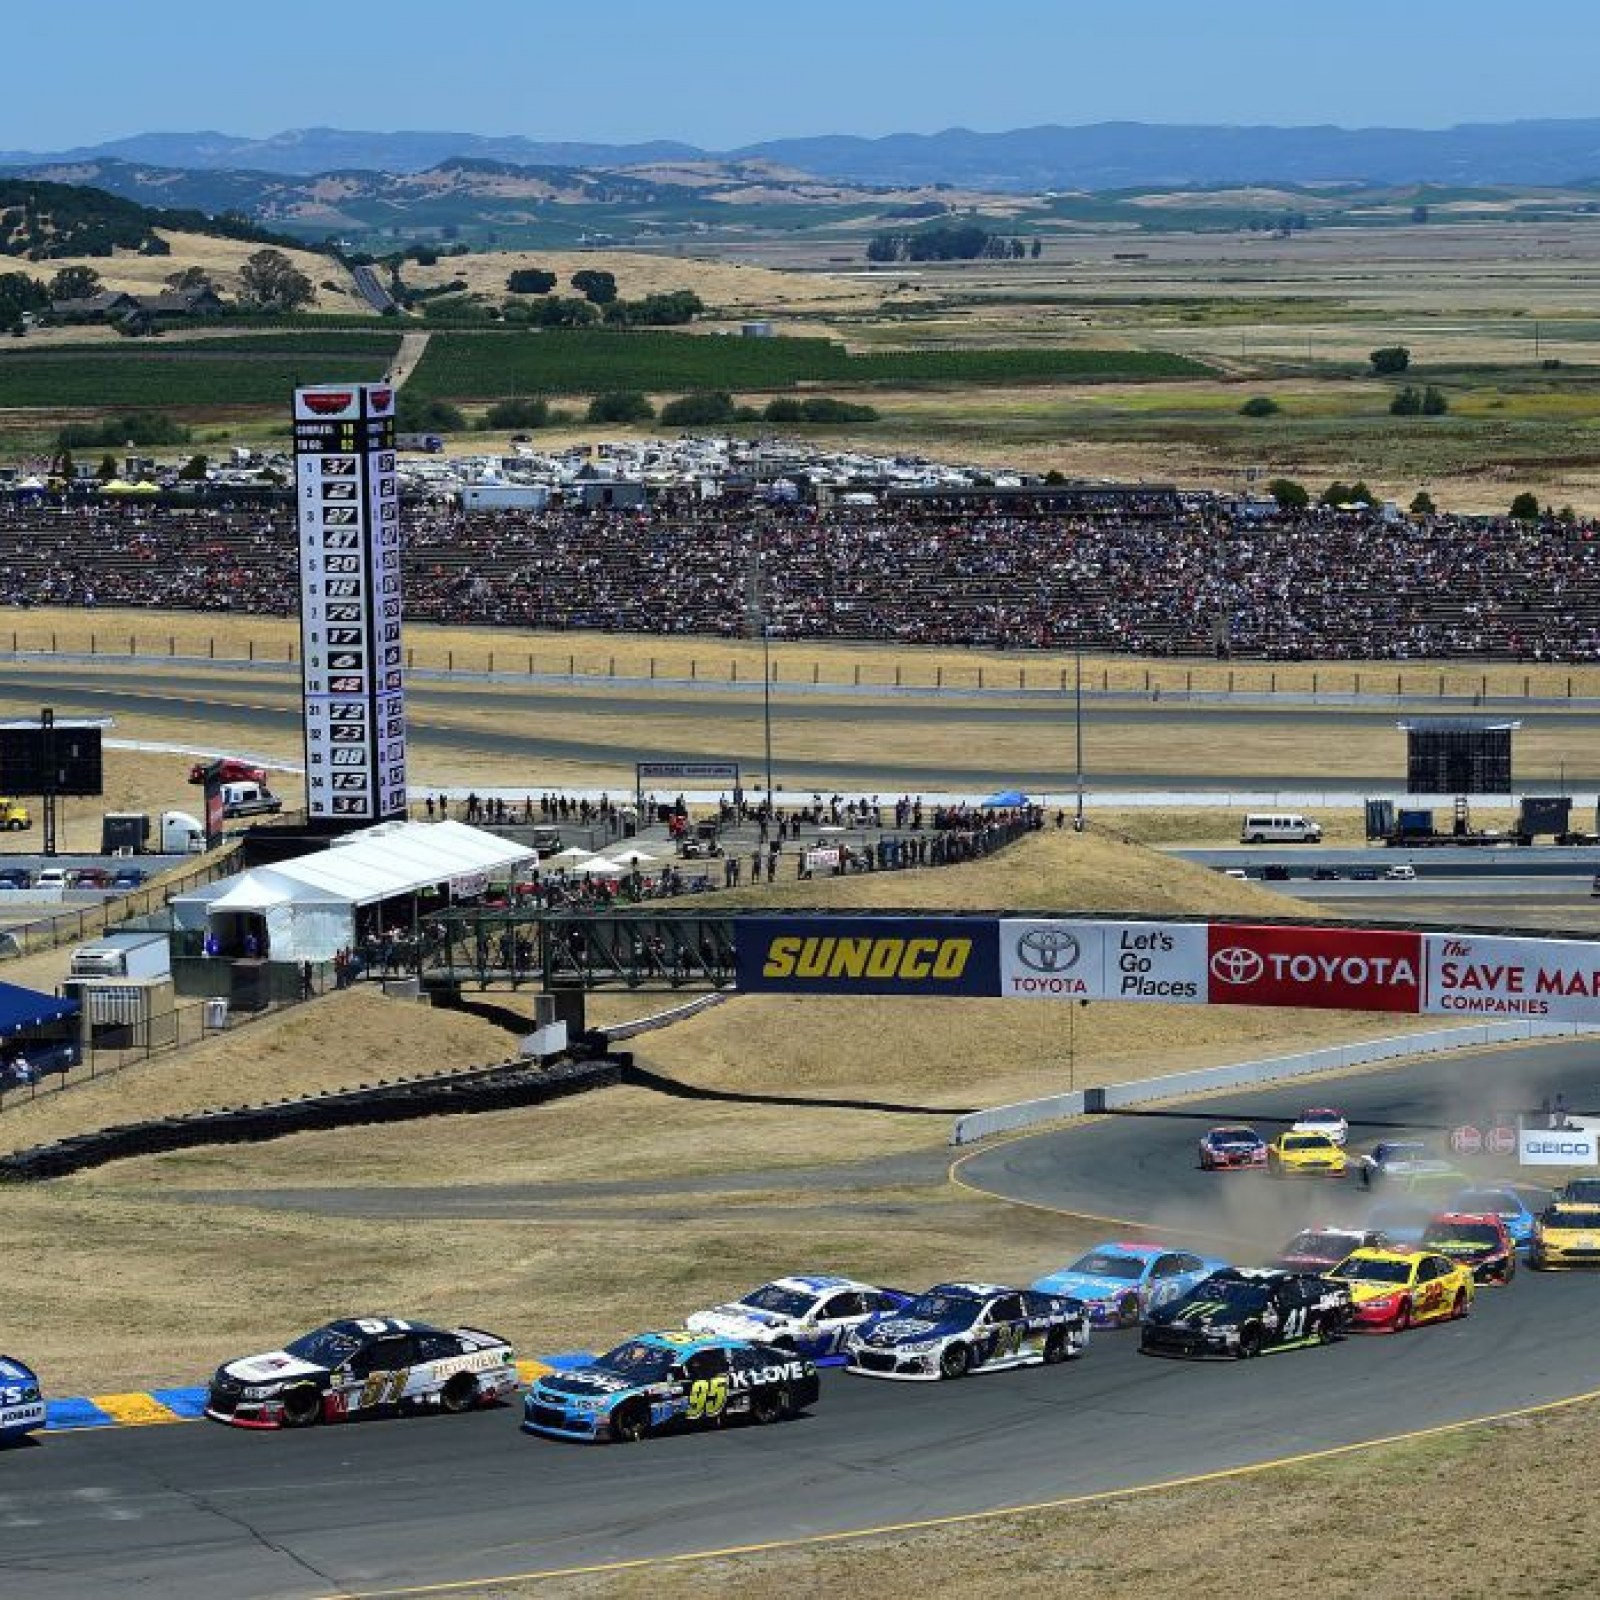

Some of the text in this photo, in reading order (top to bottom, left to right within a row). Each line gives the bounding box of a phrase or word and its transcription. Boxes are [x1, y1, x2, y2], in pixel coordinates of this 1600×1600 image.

[325, 531, 356, 547] 47
[328, 556, 356, 572] 20
[330, 629, 359, 643] 17
[332, 677, 360, 691] 42
[1121, 930, 1173, 951] Let's
[1442, 939, 1473, 957] The
[763, 936, 973, 979] SUNOCO
[1120, 953, 1152, 973] Go
[1268, 954, 1416, 985] TOYOTA
[1441, 962, 1525, 993] SAVE
[1012, 978, 1087, 993] TOYOTA
[1121, 976, 1198, 997] Places
[1441, 995, 1548, 1014] COMPANIES
[1526, 1141, 1590, 1156] GEICO
[1283, 1306, 1308, 1340] 41
[686, 1378, 728, 1420] 95
